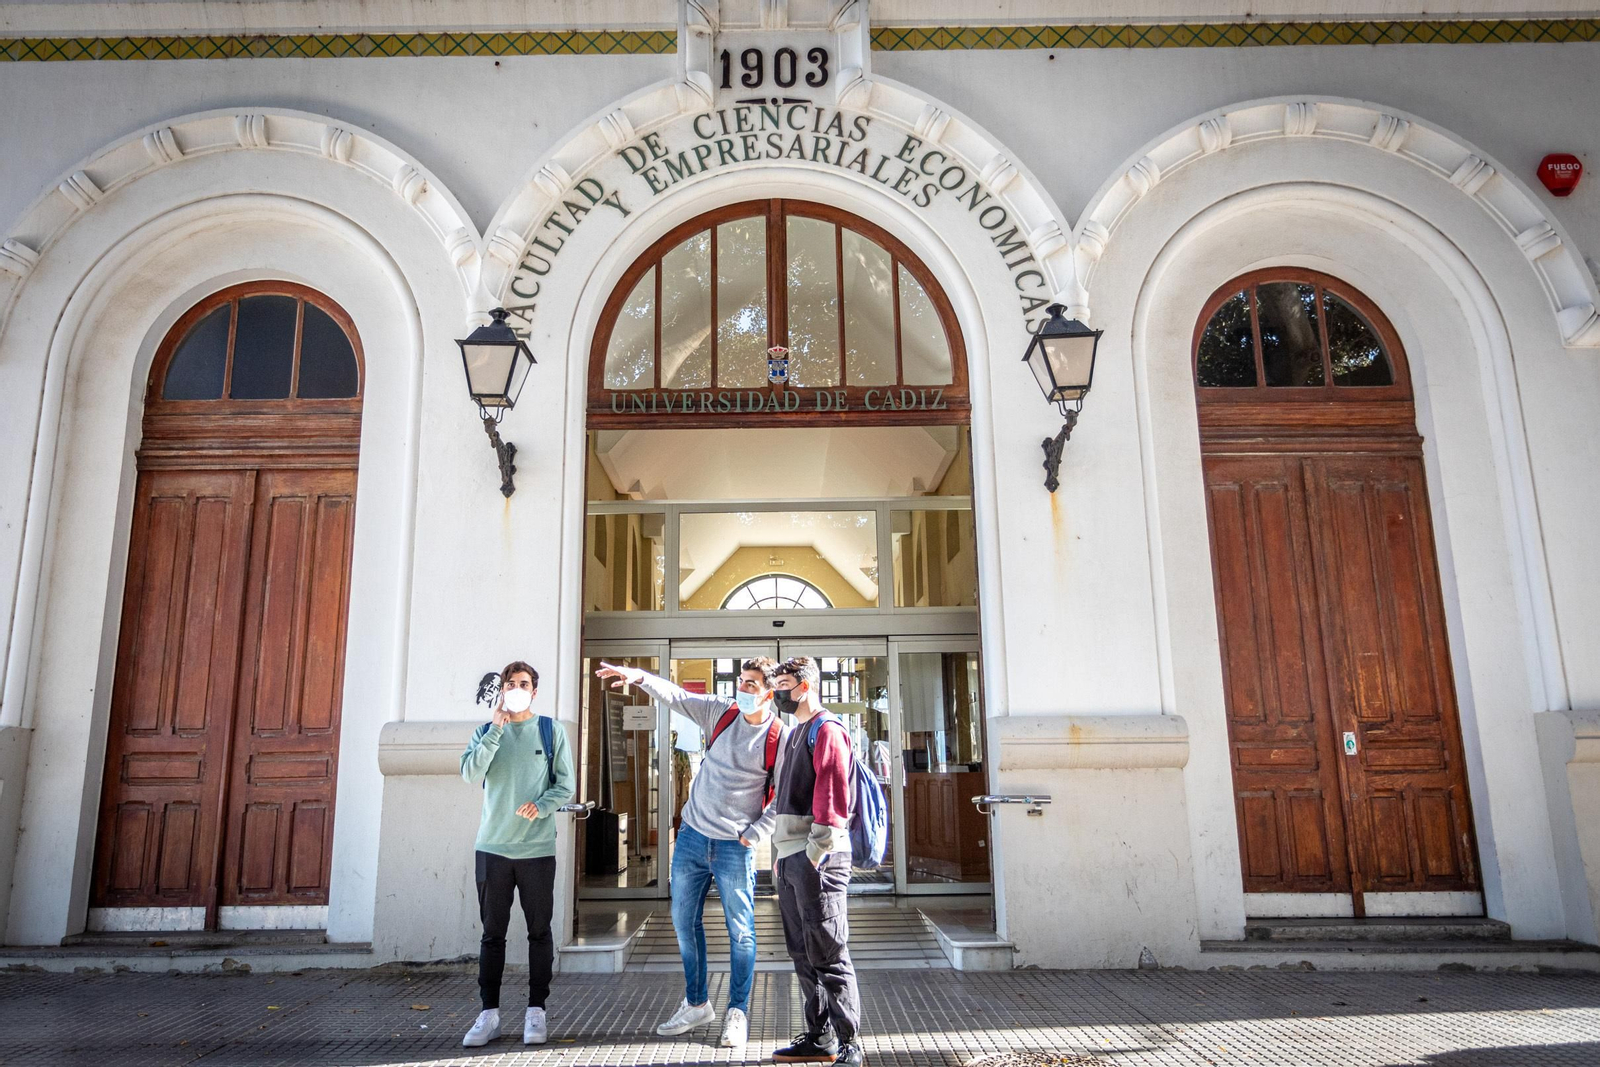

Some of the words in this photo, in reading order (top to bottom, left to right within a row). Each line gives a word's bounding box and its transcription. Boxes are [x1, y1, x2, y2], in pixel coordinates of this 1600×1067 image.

[720, 47, 829, 89] 1903
[601, 191, 631, 219] Y
[639, 133, 941, 208] EMPRESARIALES
[617, 131, 669, 175] DE
[693, 104, 871, 142] CIENCIAS
[894, 134, 1051, 335] ECONOMICAS
[611, 390, 800, 414] UNIVERSIDAD
[814, 390, 848, 412] DE
[864, 388, 947, 412] CADIZ
